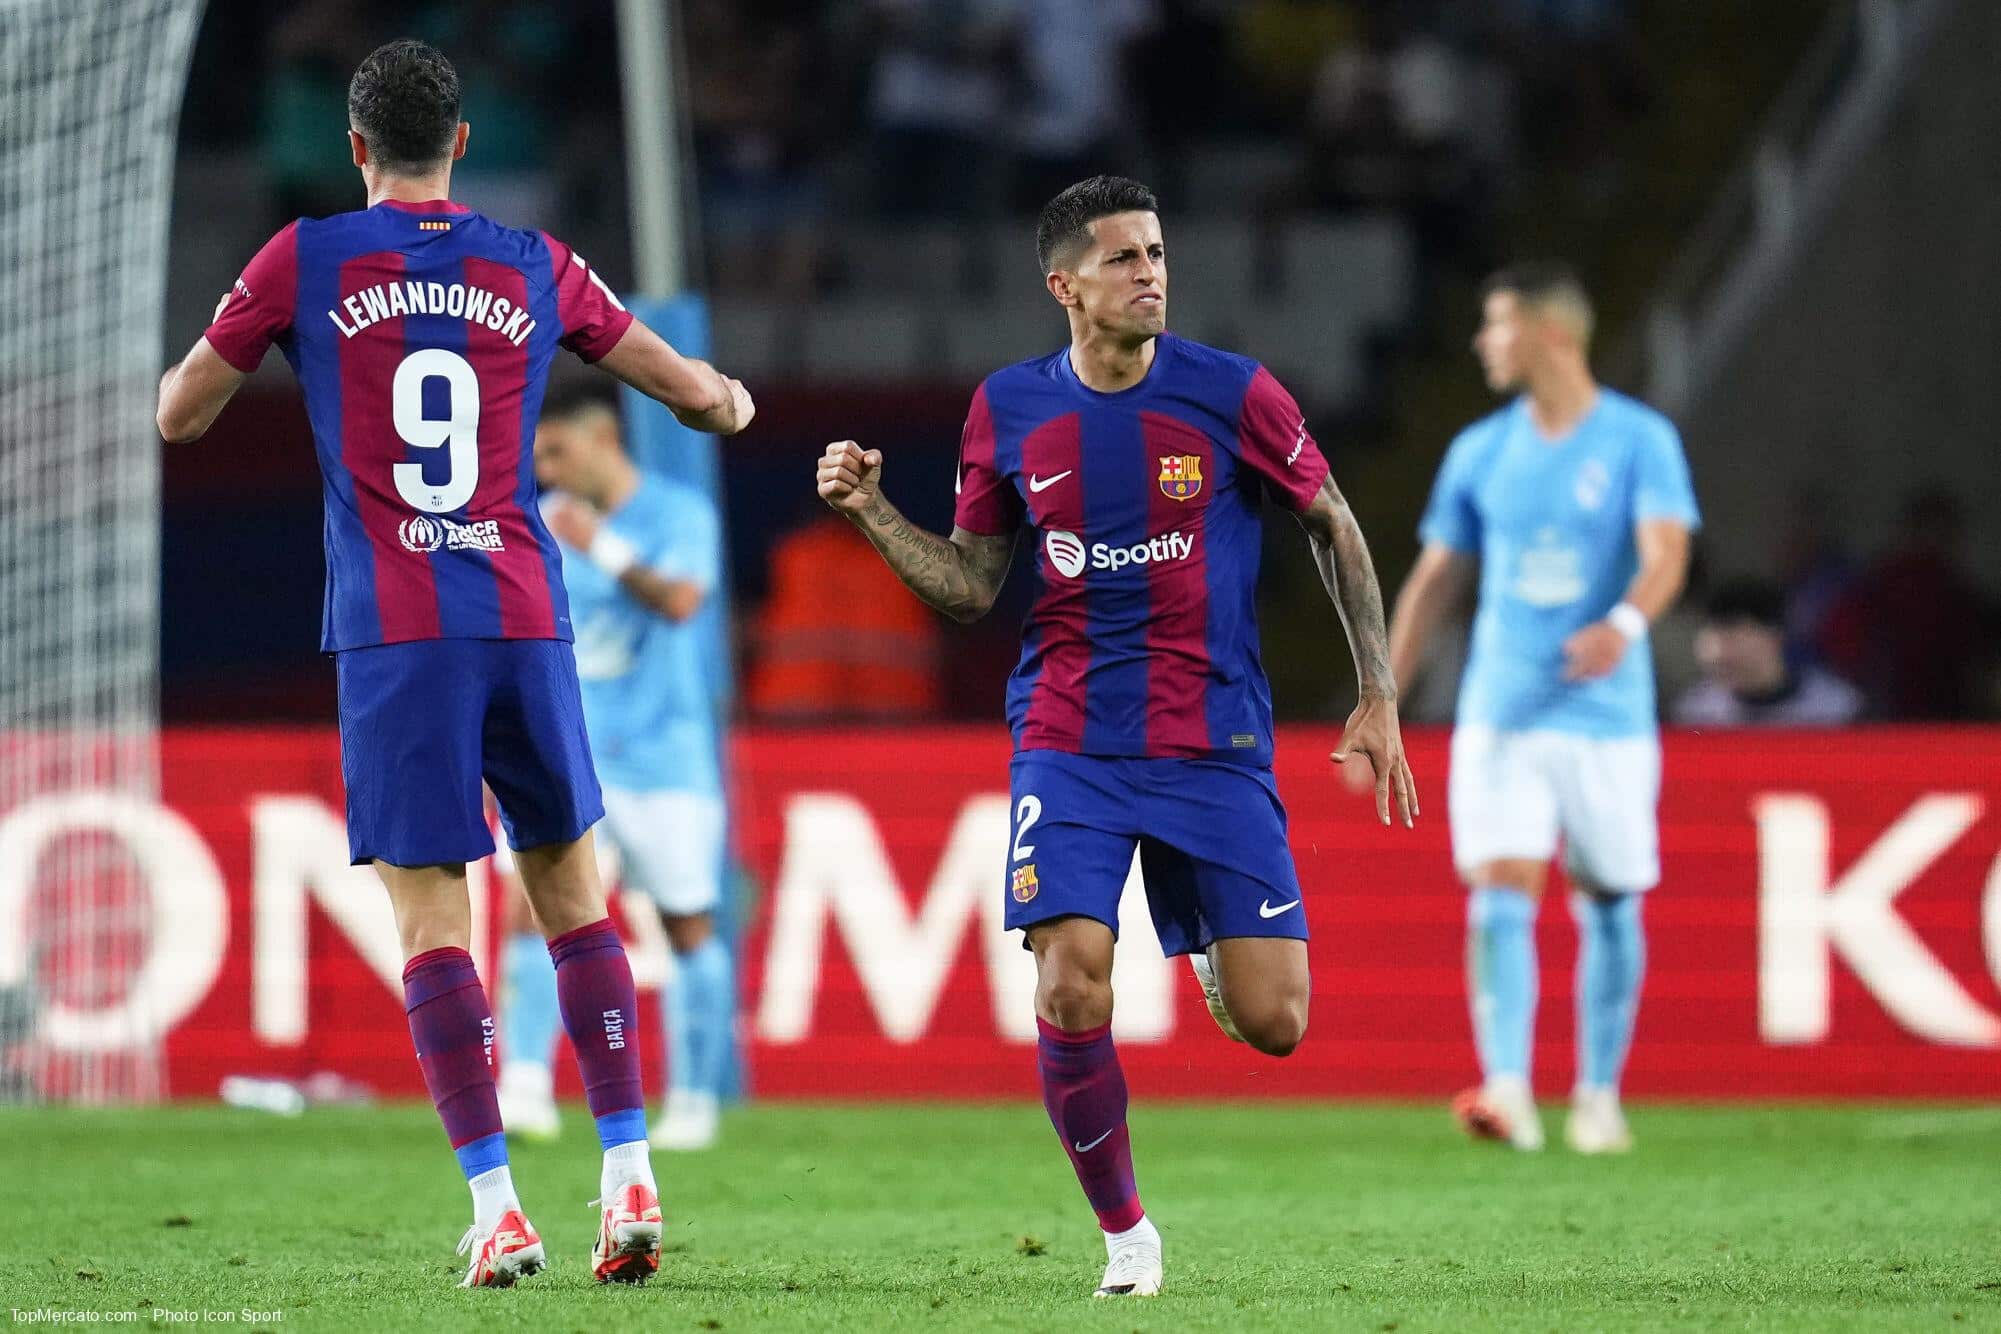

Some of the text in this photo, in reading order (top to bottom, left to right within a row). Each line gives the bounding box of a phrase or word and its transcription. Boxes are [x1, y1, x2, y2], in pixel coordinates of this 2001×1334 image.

[328, 281, 536, 347] LEWANDOWSKI
[392, 348, 480, 513] 9
[1091, 531, 1194, 571] Spotify
[1013, 794, 1042, 862] 2
[1752, 792, 2001, 1046] K
[603, 1008, 625, 1050] BARÇA
